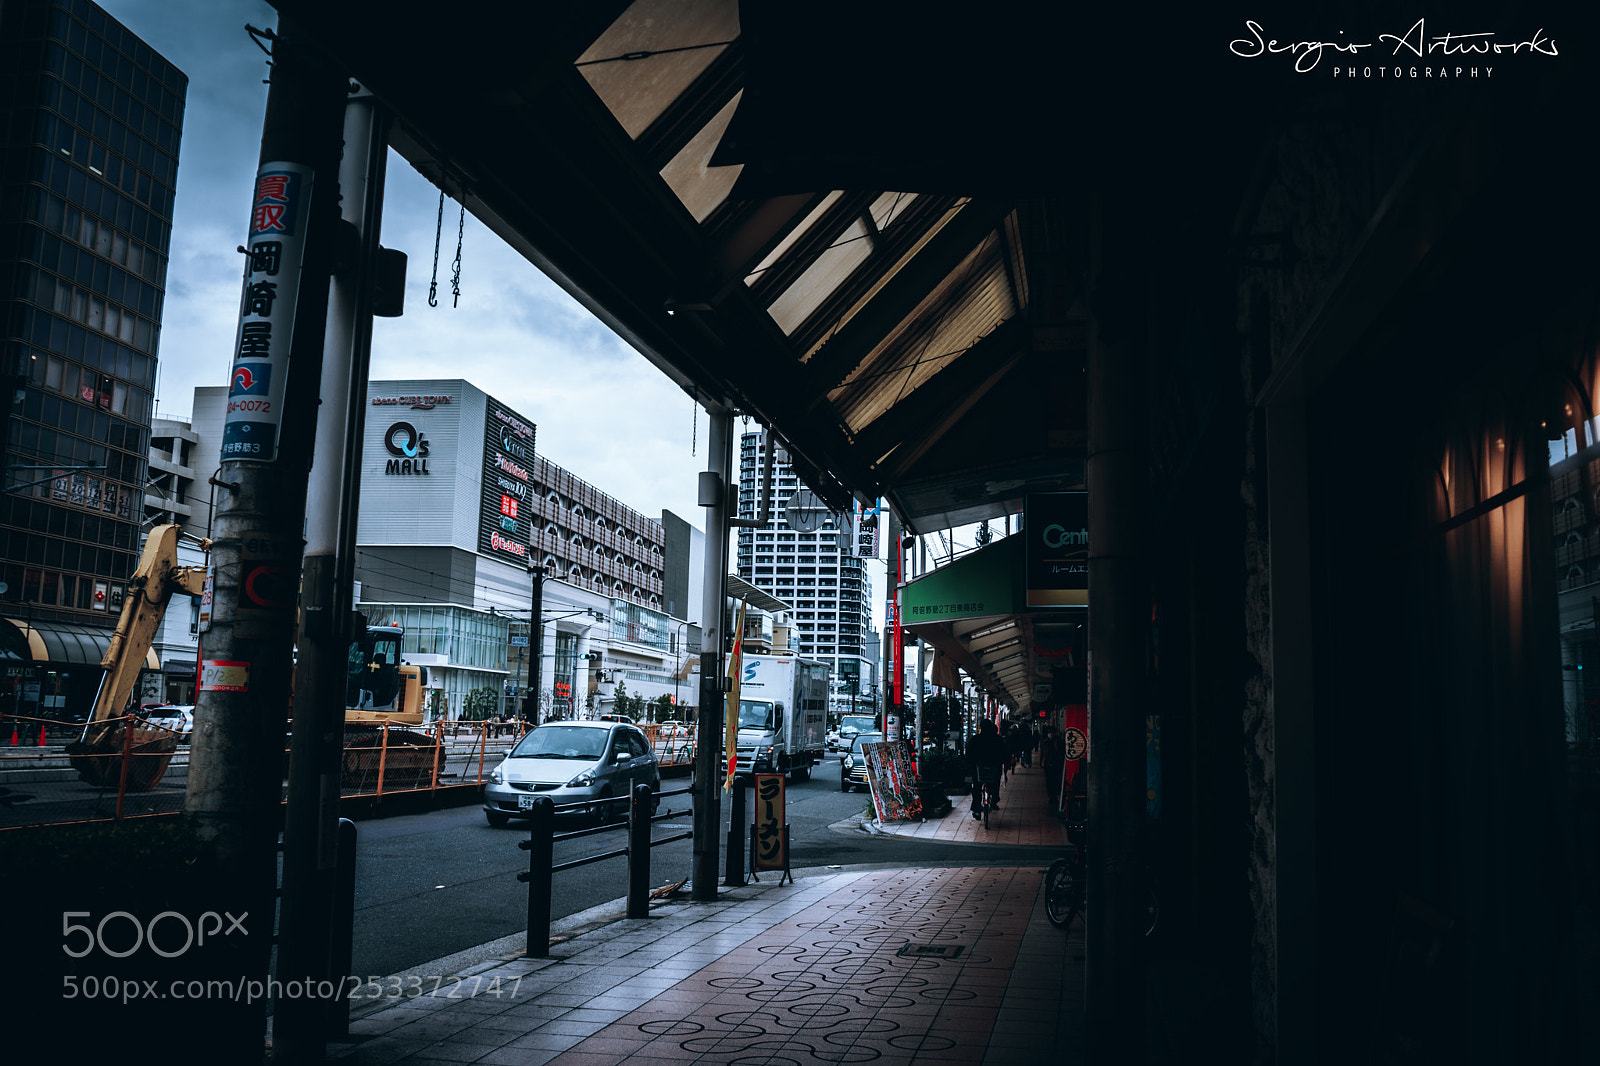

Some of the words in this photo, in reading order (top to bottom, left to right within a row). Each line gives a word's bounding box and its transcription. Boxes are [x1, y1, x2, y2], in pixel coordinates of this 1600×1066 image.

[251, 174, 290, 231] 買取
[238, 241, 282, 358] 岡崎屋
[371, 397, 397, 405] abeno
[398, 396, 422, 405] CUES
[424, 395, 451, 404] TOWN
[384, 421, 429, 457] Q's
[385, 459, 429, 475] MALL
[1051, 564, 1088, 574] ルームエ
[888, 761, 901, 795] 580
[759, 778, 780, 860] ラーメン
[874, 792, 884, 821] 500
